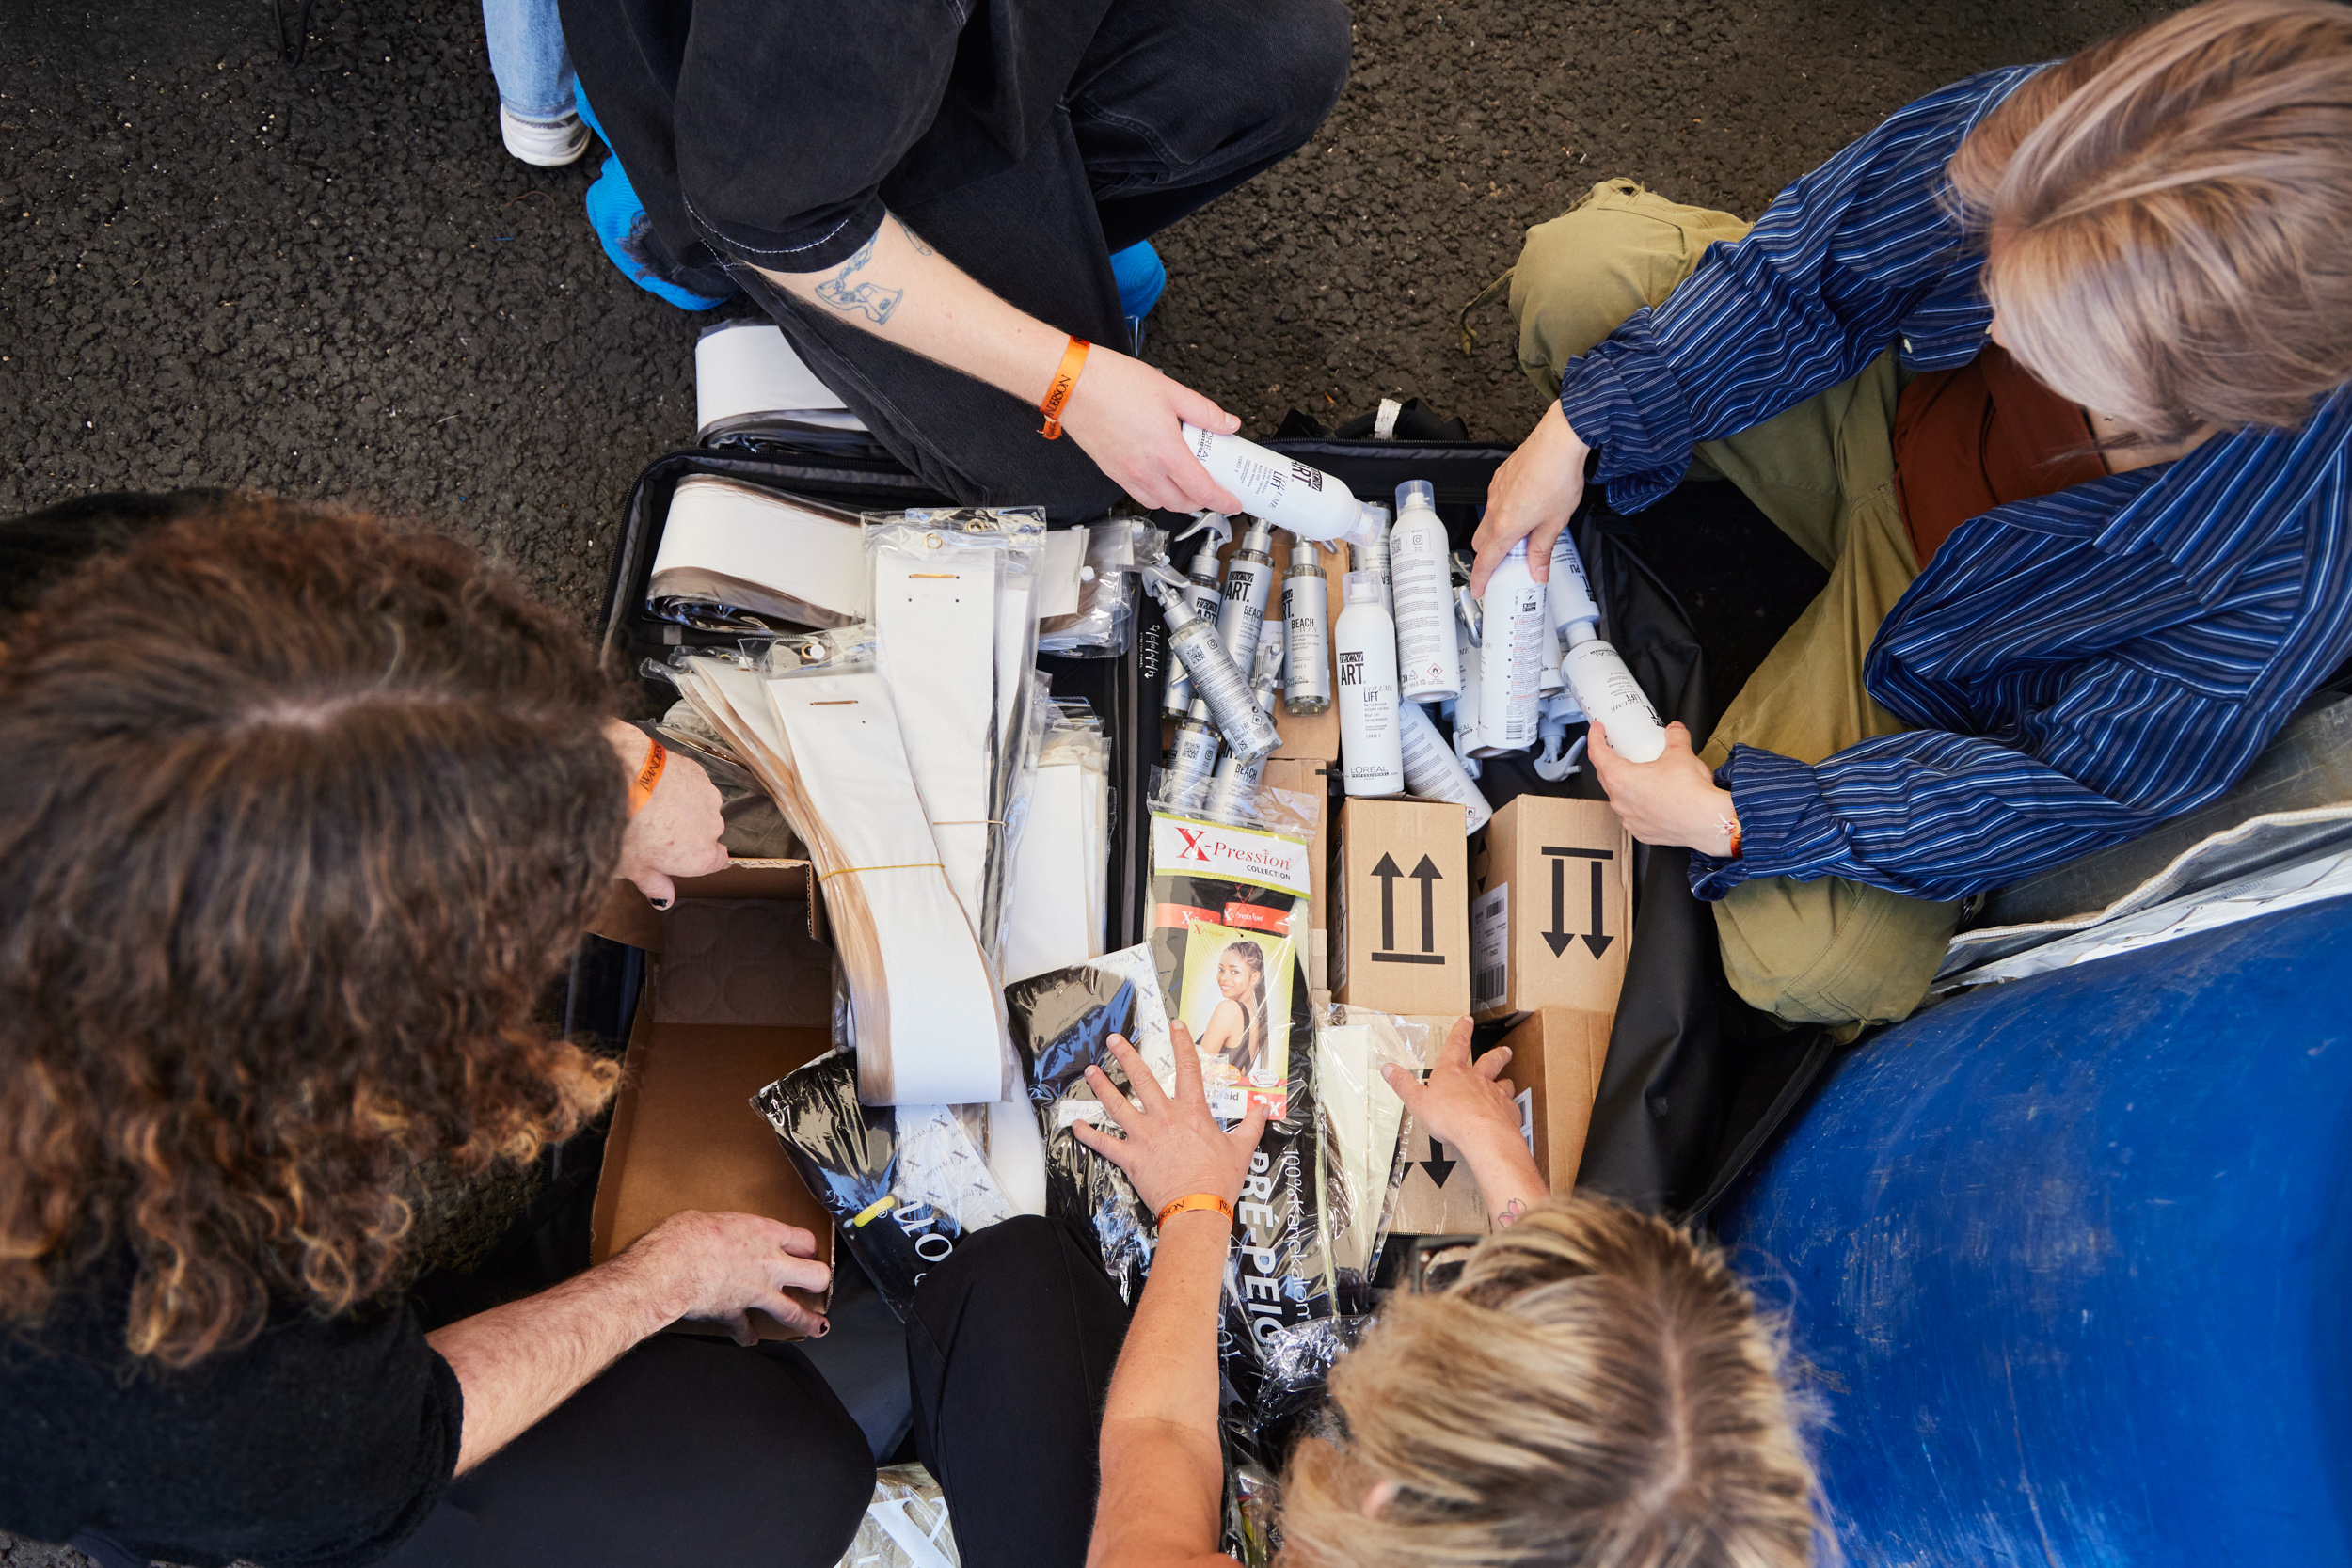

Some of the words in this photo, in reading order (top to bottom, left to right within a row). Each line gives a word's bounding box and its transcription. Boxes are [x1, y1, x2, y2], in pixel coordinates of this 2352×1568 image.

[1269, 470, 1284, 490] LIFT
[1244, 605, 1263, 618] BEACH
[1291, 618, 1313, 628] BEACH
[1363, 691, 1377, 701] LIFT
[1174, 827, 1292, 870] X-Pression
[1247, 864, 1291, 880] COLLECTION
[1283, 1148, 1304, 1198] 100%
